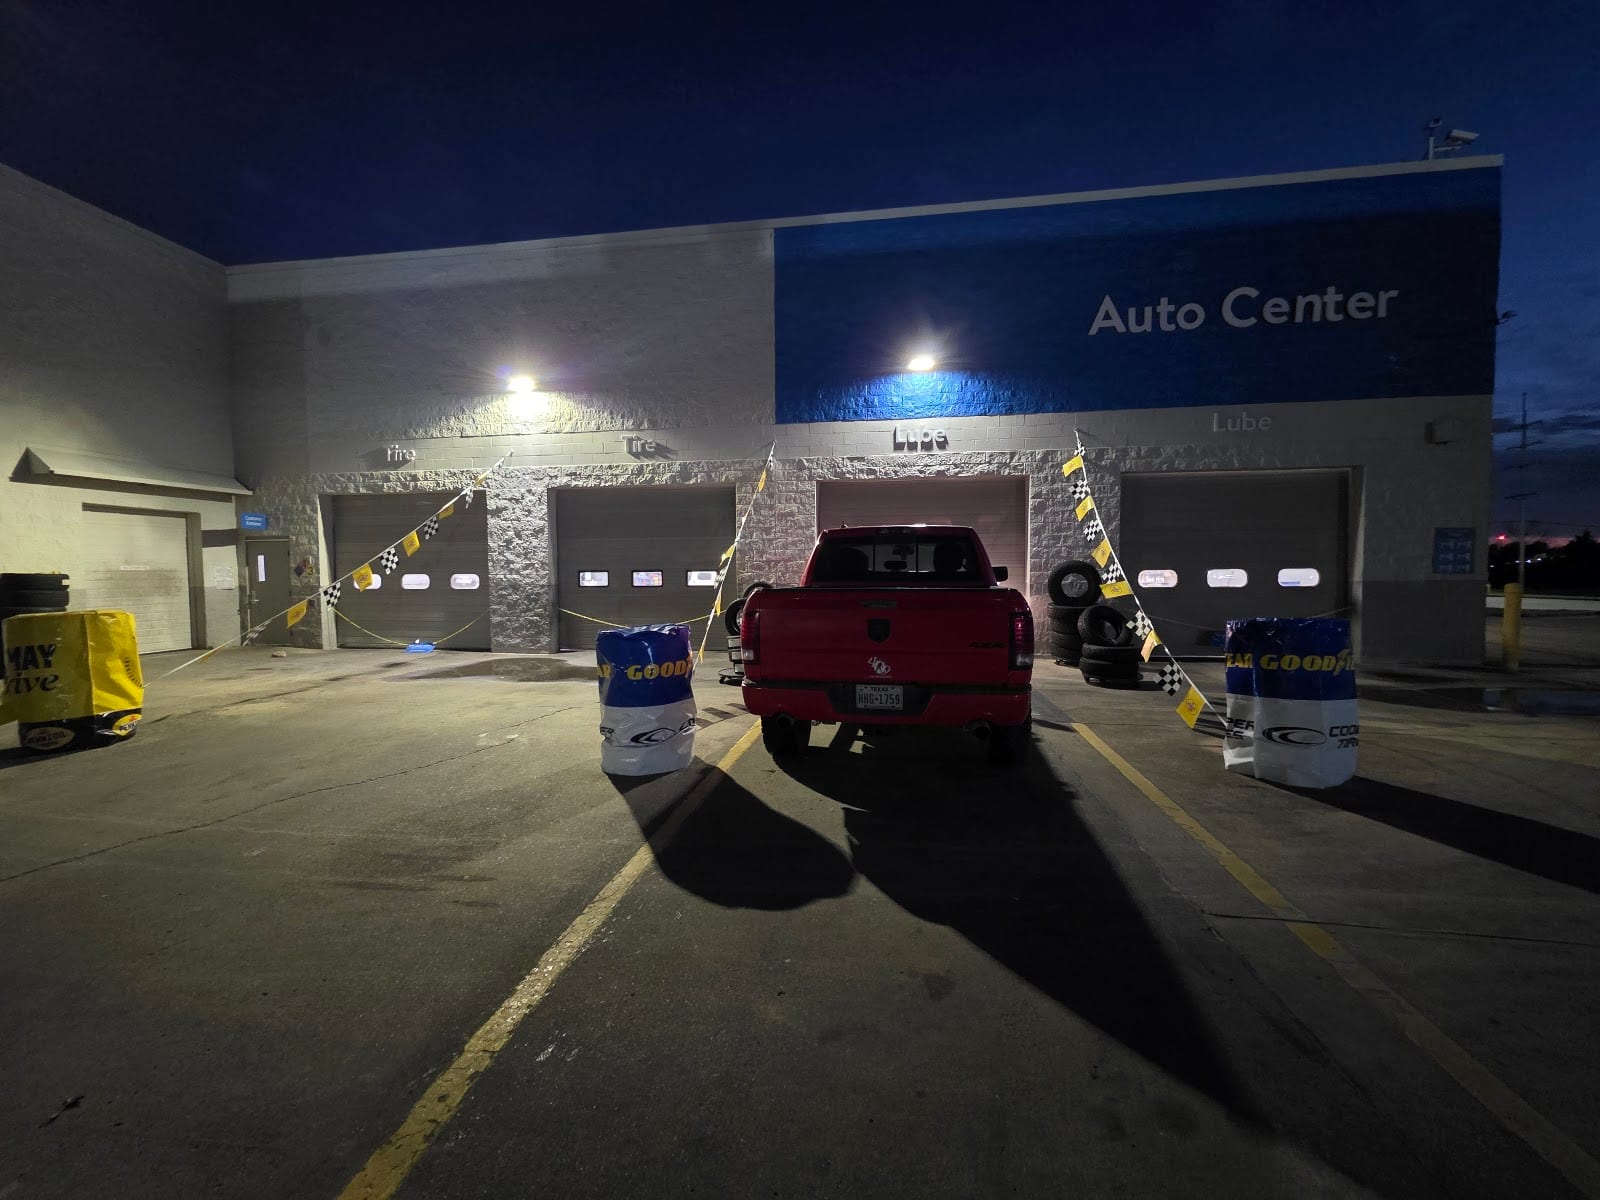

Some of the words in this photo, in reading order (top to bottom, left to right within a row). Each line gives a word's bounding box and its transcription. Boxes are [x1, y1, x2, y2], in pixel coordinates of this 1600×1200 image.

[1087, 294, 1206, 336] Auto
[1220, 285, 1400, 329] Center
[1213, 411, 1273, 433] Lube
[620, 435, 656, 454] Tire
[894, 424, 947, 447] Lube
